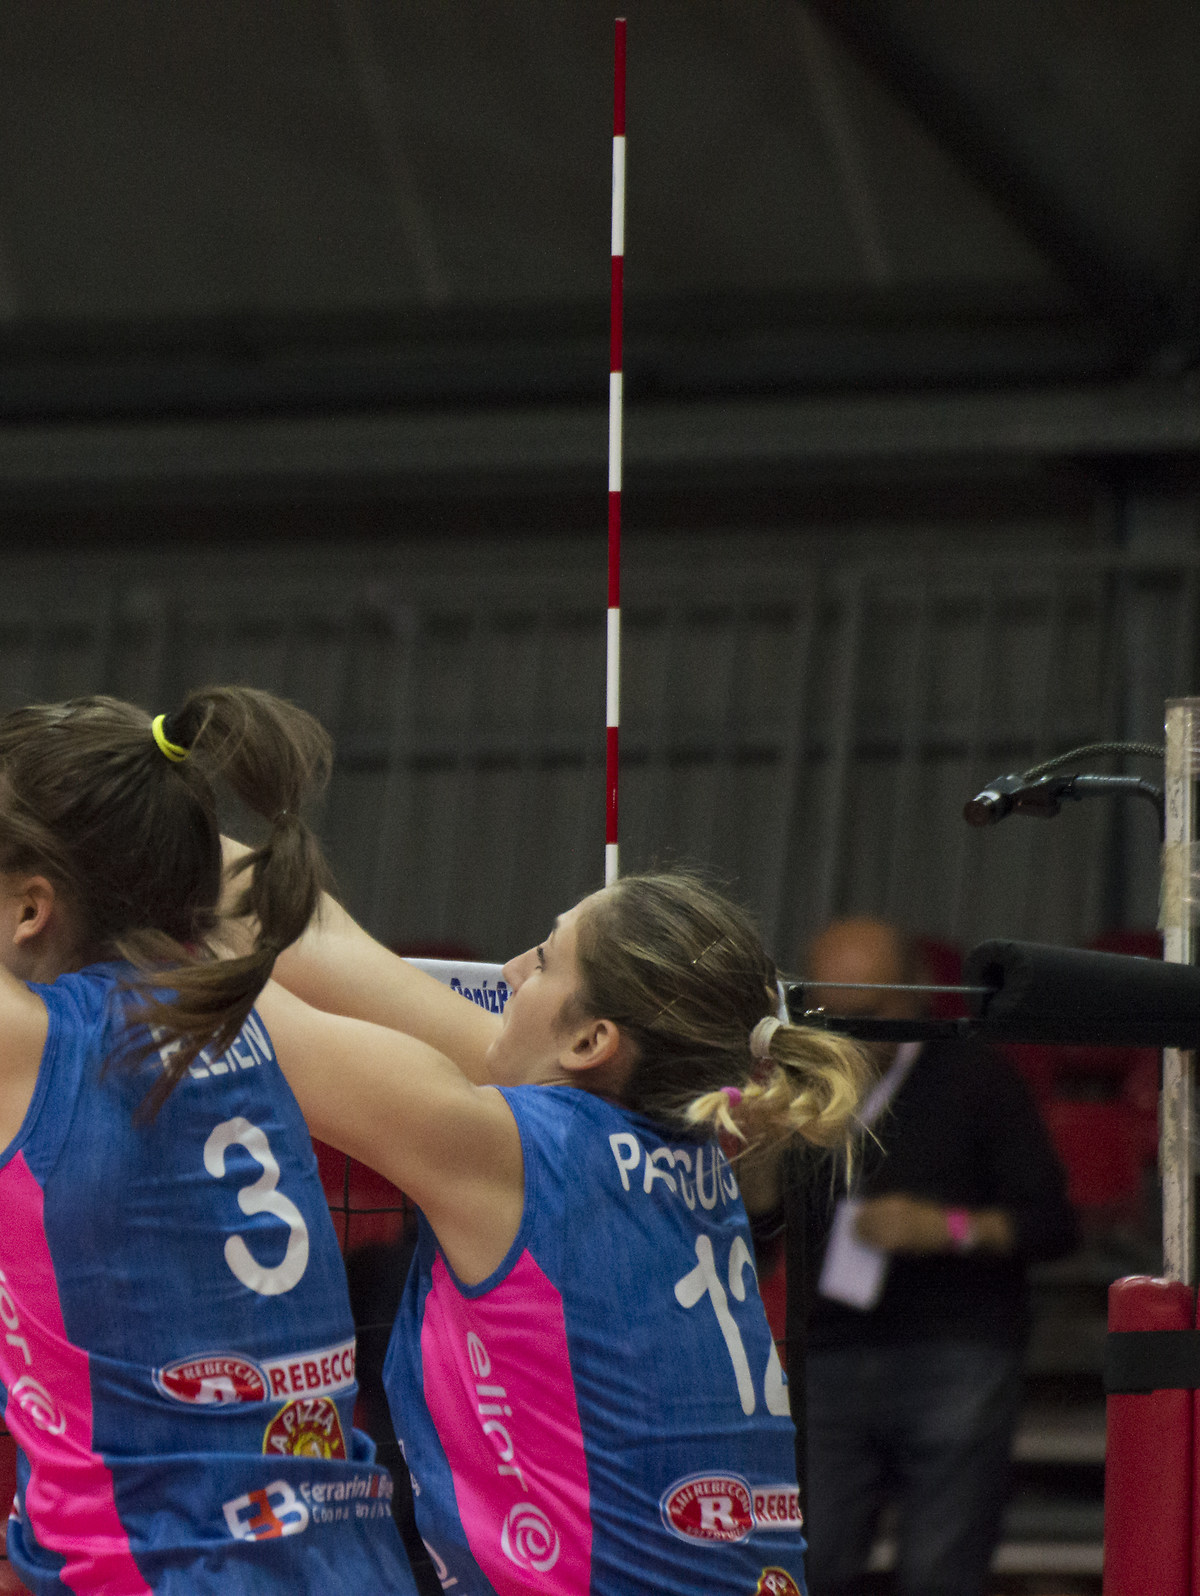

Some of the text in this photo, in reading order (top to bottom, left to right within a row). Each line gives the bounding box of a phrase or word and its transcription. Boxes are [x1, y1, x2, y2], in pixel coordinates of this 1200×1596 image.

[450, 976, 513, 1014] DenizB
[203, 1116, 310, 1296] 3
[467, 1331, 529, 1492] elior
